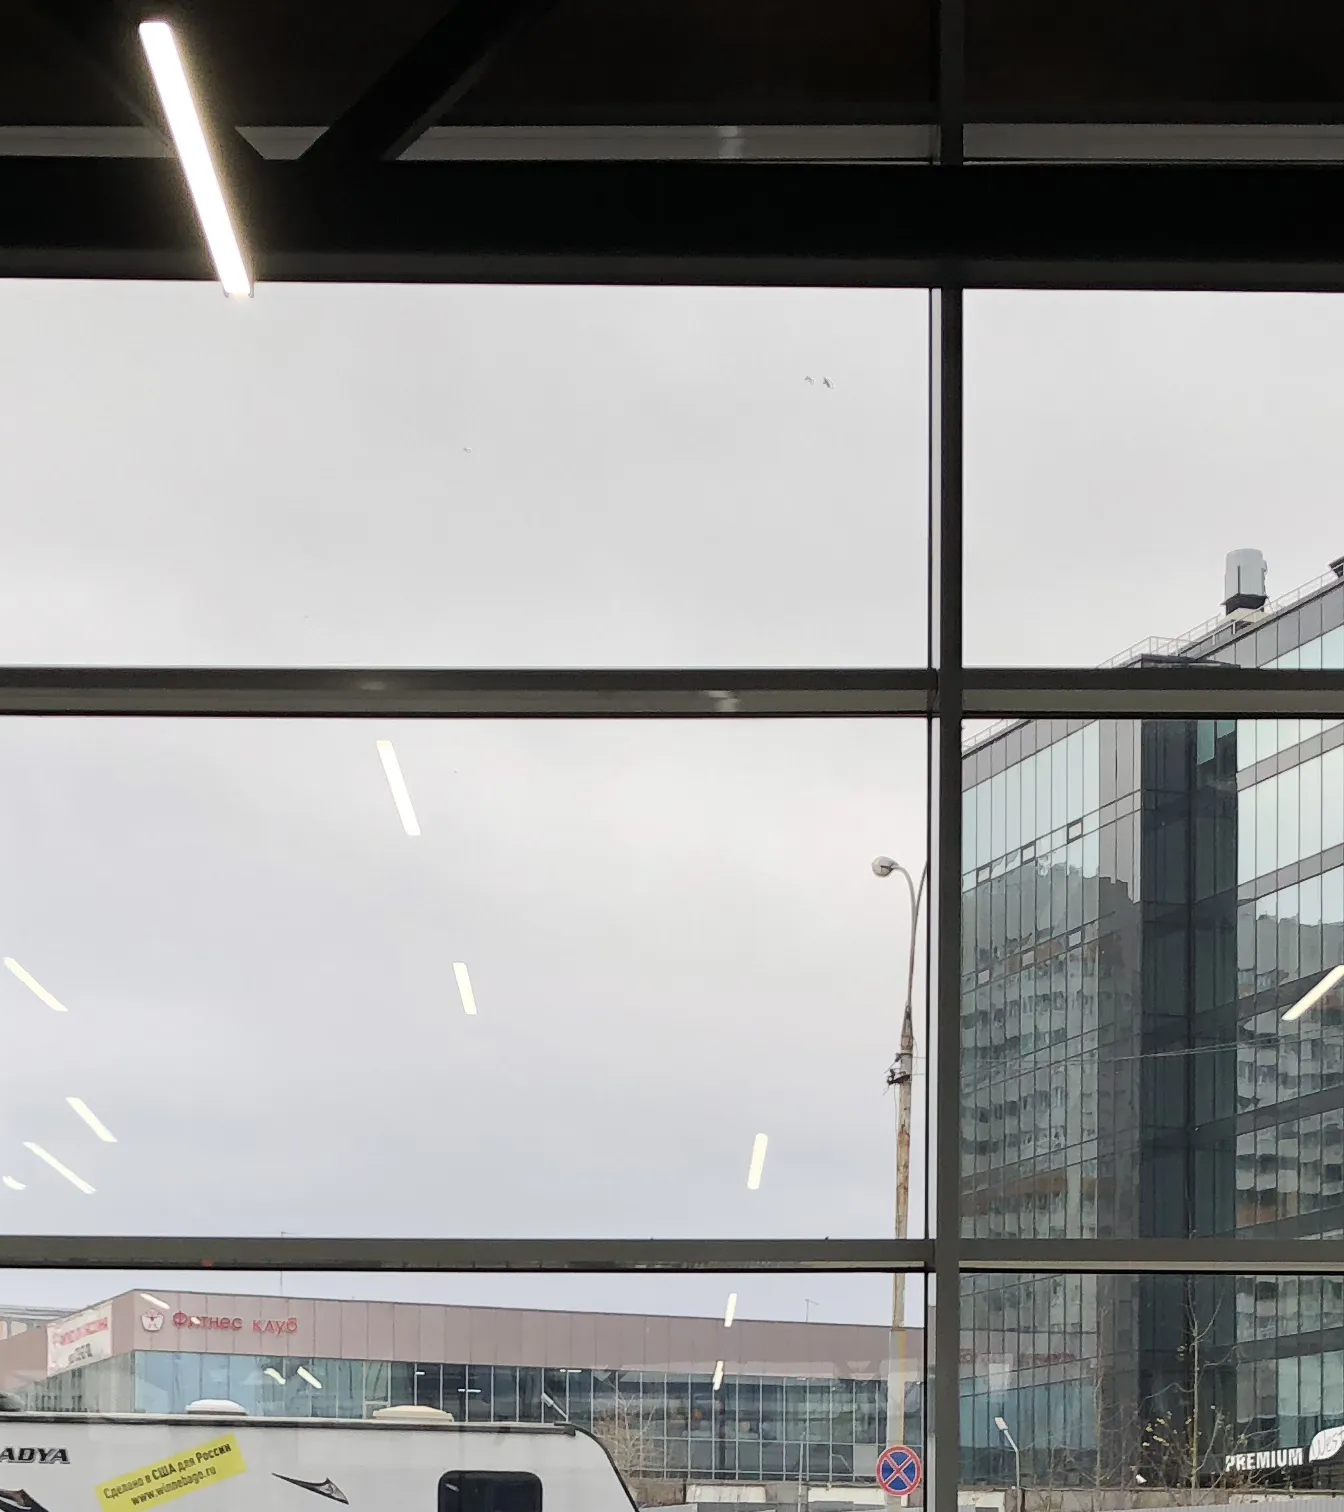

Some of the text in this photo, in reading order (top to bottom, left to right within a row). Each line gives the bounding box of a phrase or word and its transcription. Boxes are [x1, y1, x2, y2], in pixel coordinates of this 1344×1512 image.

[103, 1477, 144, 1499] Сделано
[151, 1463, 177, 1480] США
[177, 1458, 196, 1473] для
[195, 1443, 232, 1463] России
[1225, 1448, 1304, 1472] PREMIUM
